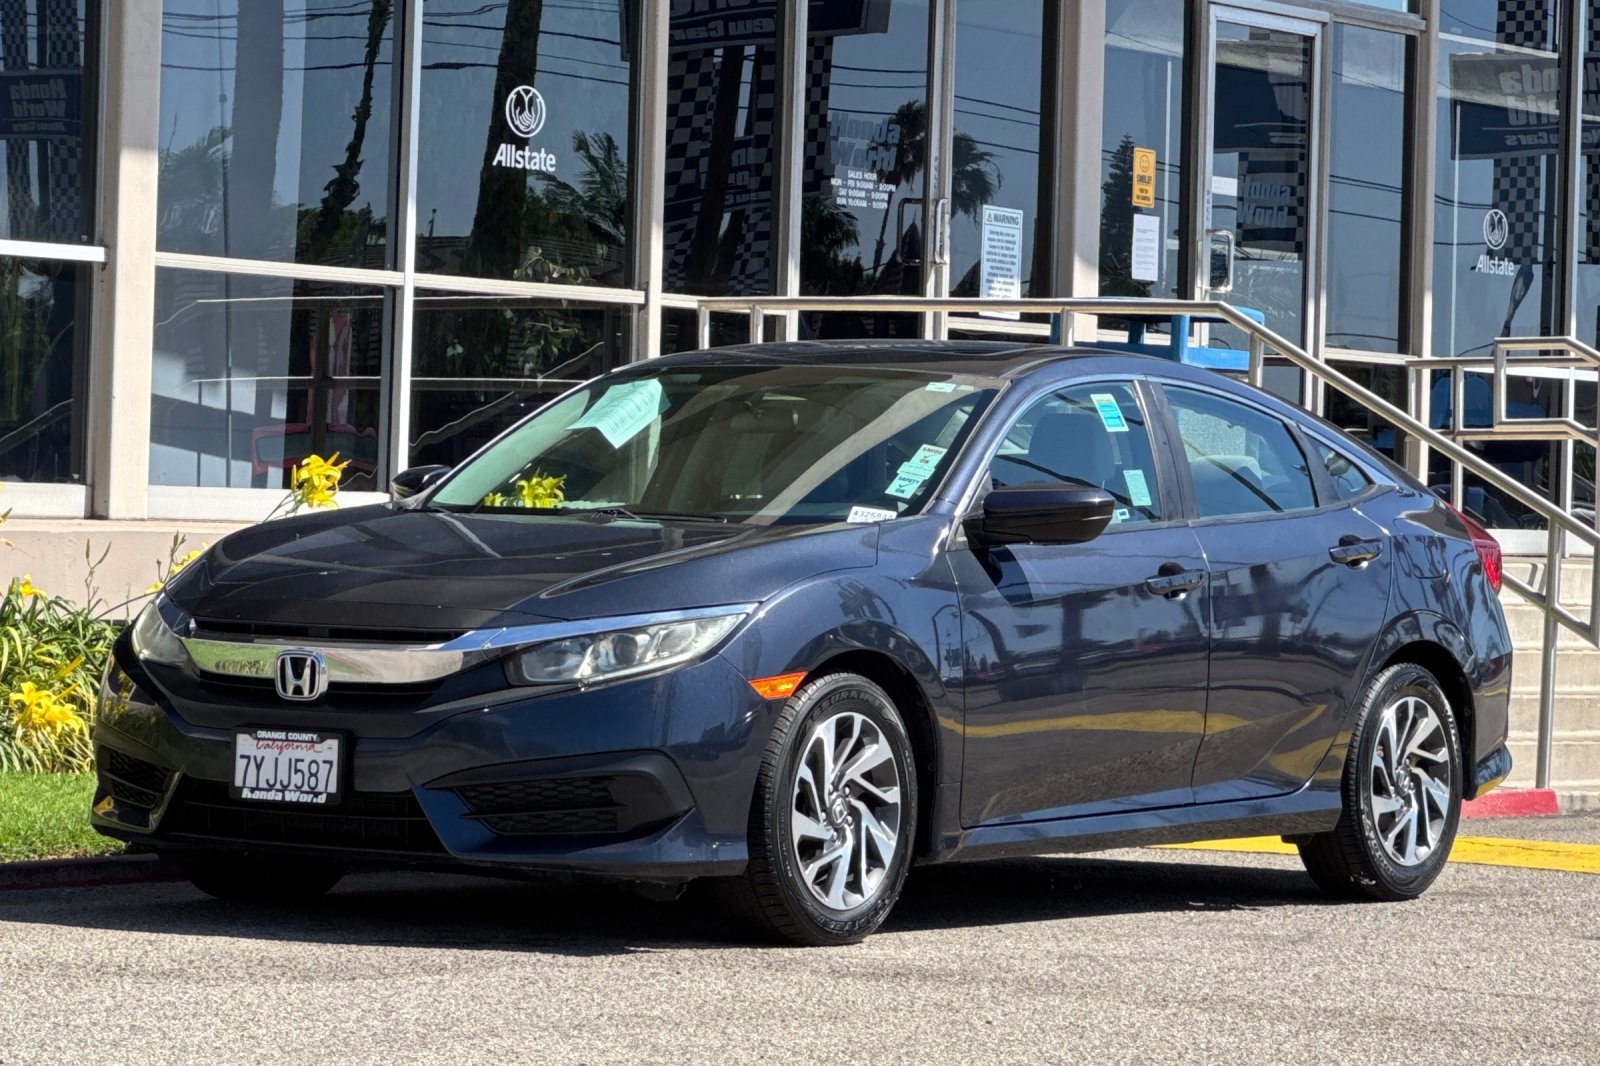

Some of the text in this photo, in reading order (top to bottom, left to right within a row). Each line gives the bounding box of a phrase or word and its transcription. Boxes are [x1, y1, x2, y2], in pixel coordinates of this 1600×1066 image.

[829, 111, 901, 145] Honda
[492, 143, 556, 172] Allstate
[830, 140, 897, 171] World
[848, 170, 863, 179] SALES
[993, 213, 1020, 226] WARNING
[1475, 254, 1515, 276] Allstate
[257, 730, 318, 741] ORANGE COUNTY
[255, 740, 322, 756] California
[239, 754, 334, 792] 7YJJ587
[241, 788, 283, 801] Honda
